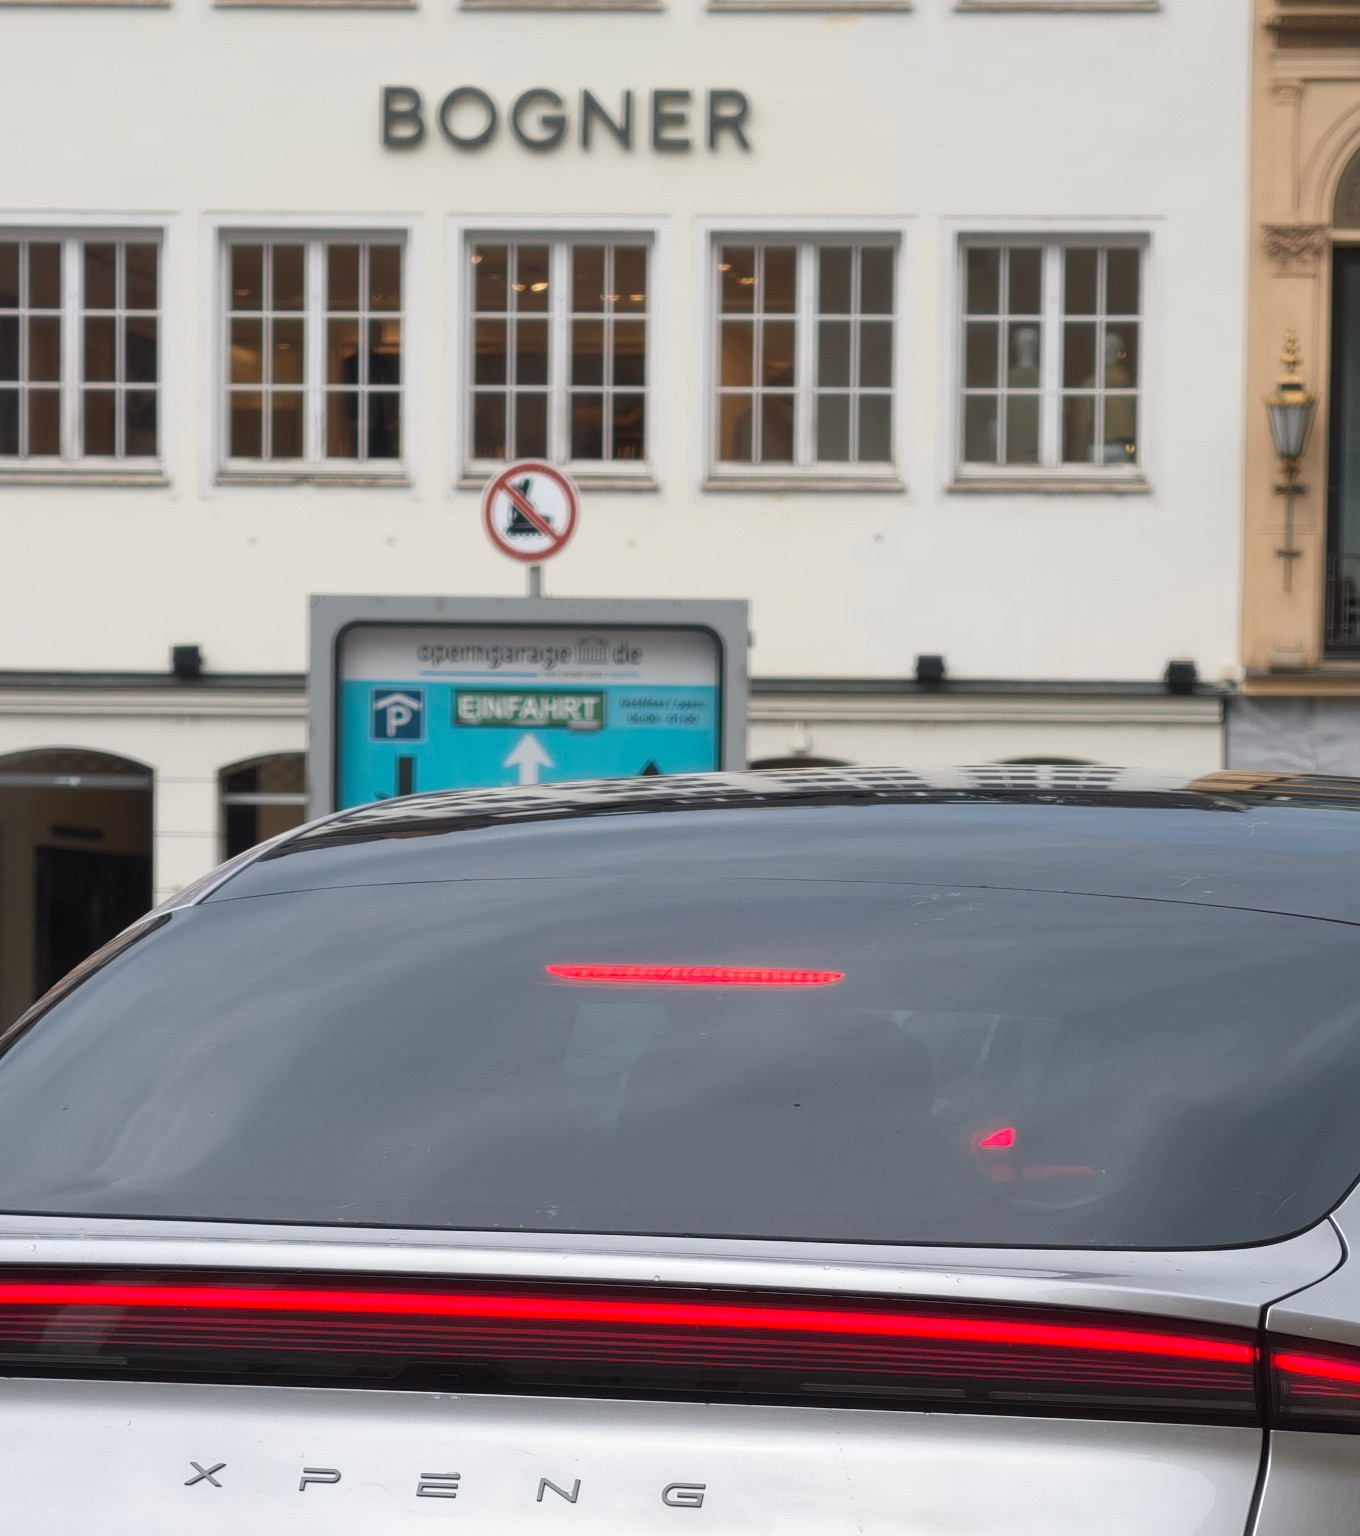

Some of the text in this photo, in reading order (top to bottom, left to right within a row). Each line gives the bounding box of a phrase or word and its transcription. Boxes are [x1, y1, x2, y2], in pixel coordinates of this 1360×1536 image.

[382, 85, 753, 153] BOGNER
[456, 694, 601, 724] EINFAHRT
[183, 1461, 707, 1509] XPENG
